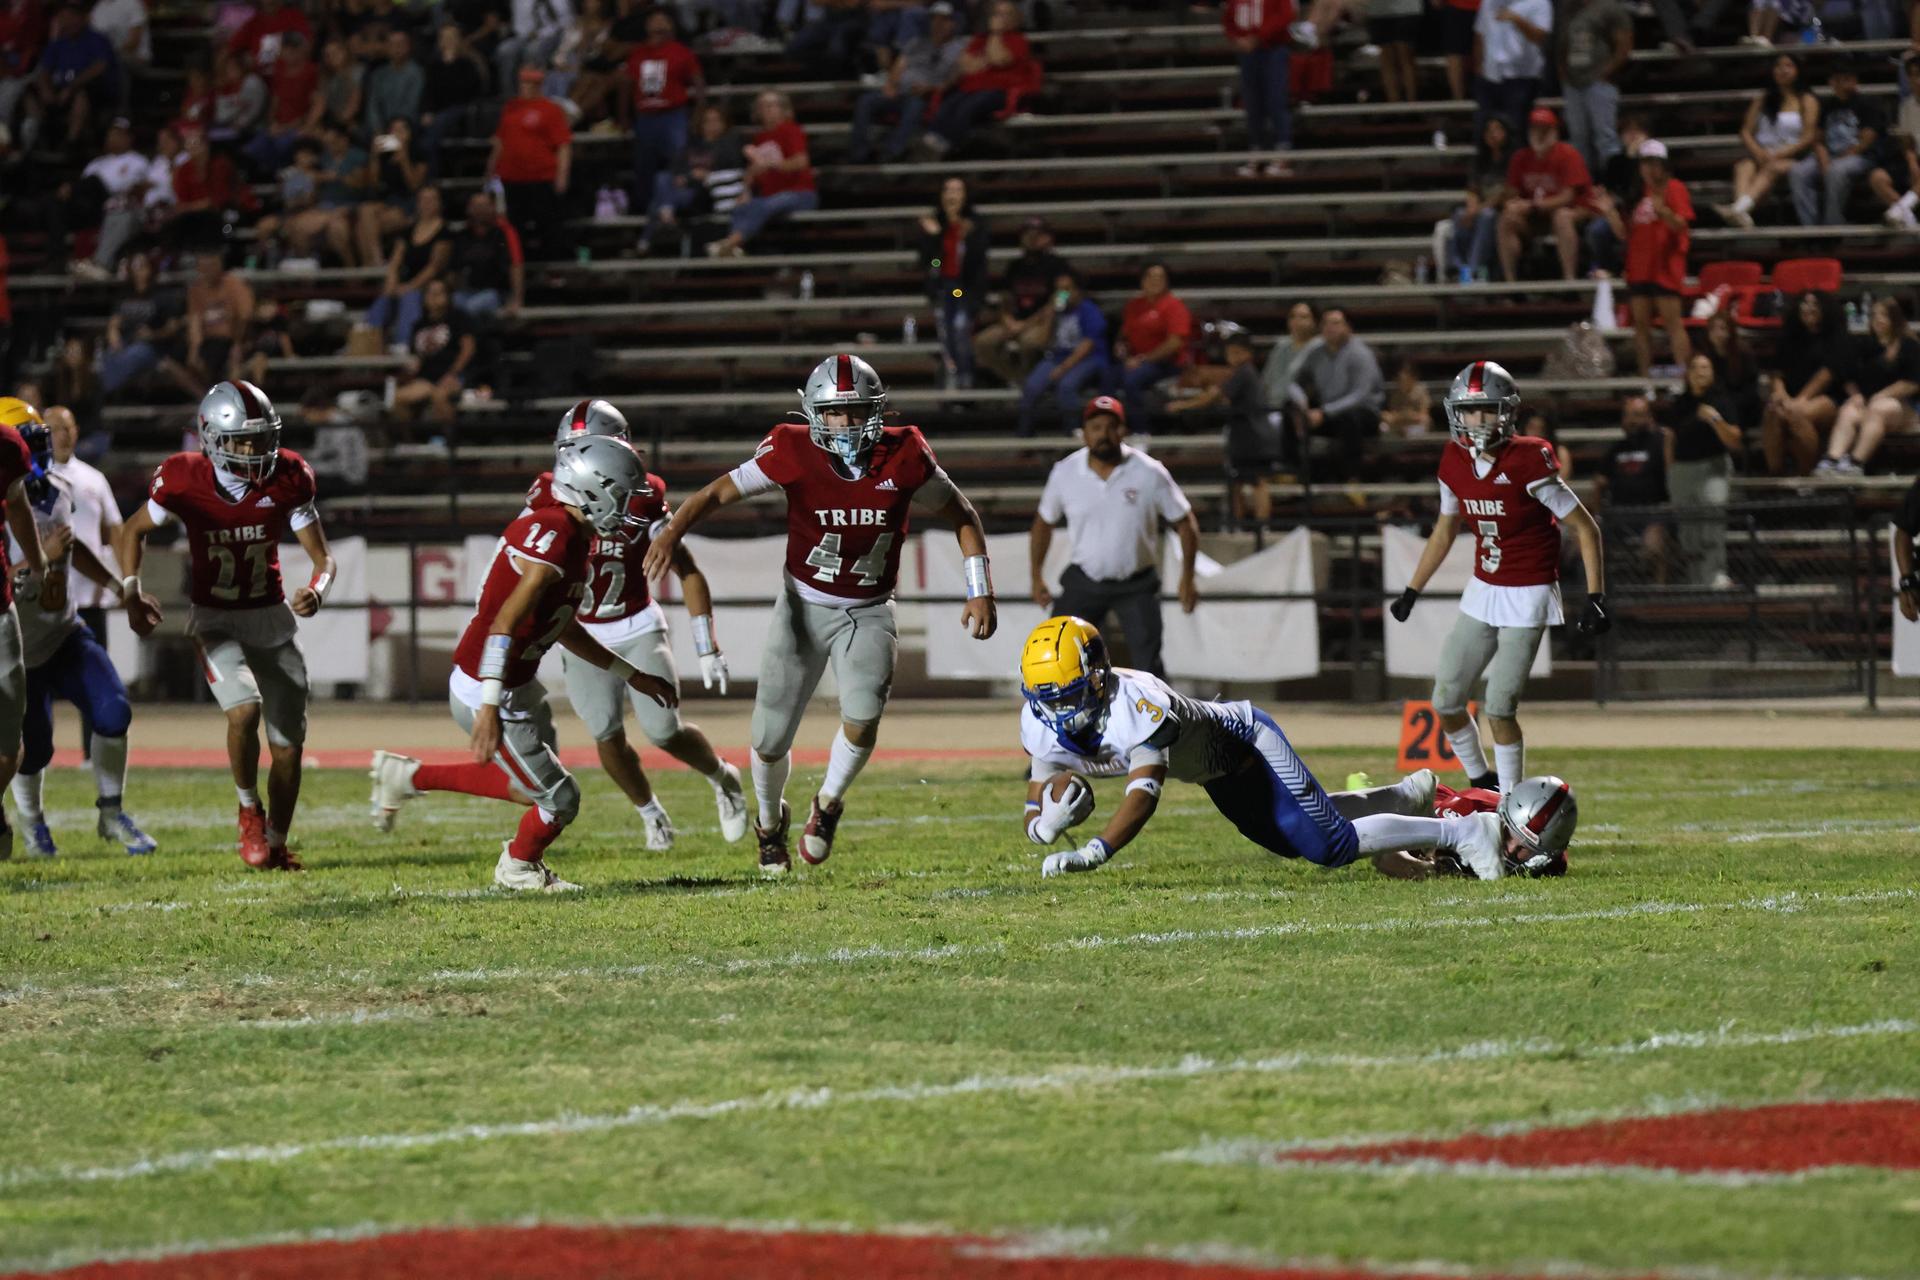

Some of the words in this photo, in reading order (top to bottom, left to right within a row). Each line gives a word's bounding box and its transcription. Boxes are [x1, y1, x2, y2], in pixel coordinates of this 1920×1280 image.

[815, 508, 887, 526] TRIBE
[1463, 499, 1506, 516] TRIBE
[205, 524, 267, 544] TRIBE
[805, 532, 894, 586] 44
[1135, 697, 1164, 723] 3
